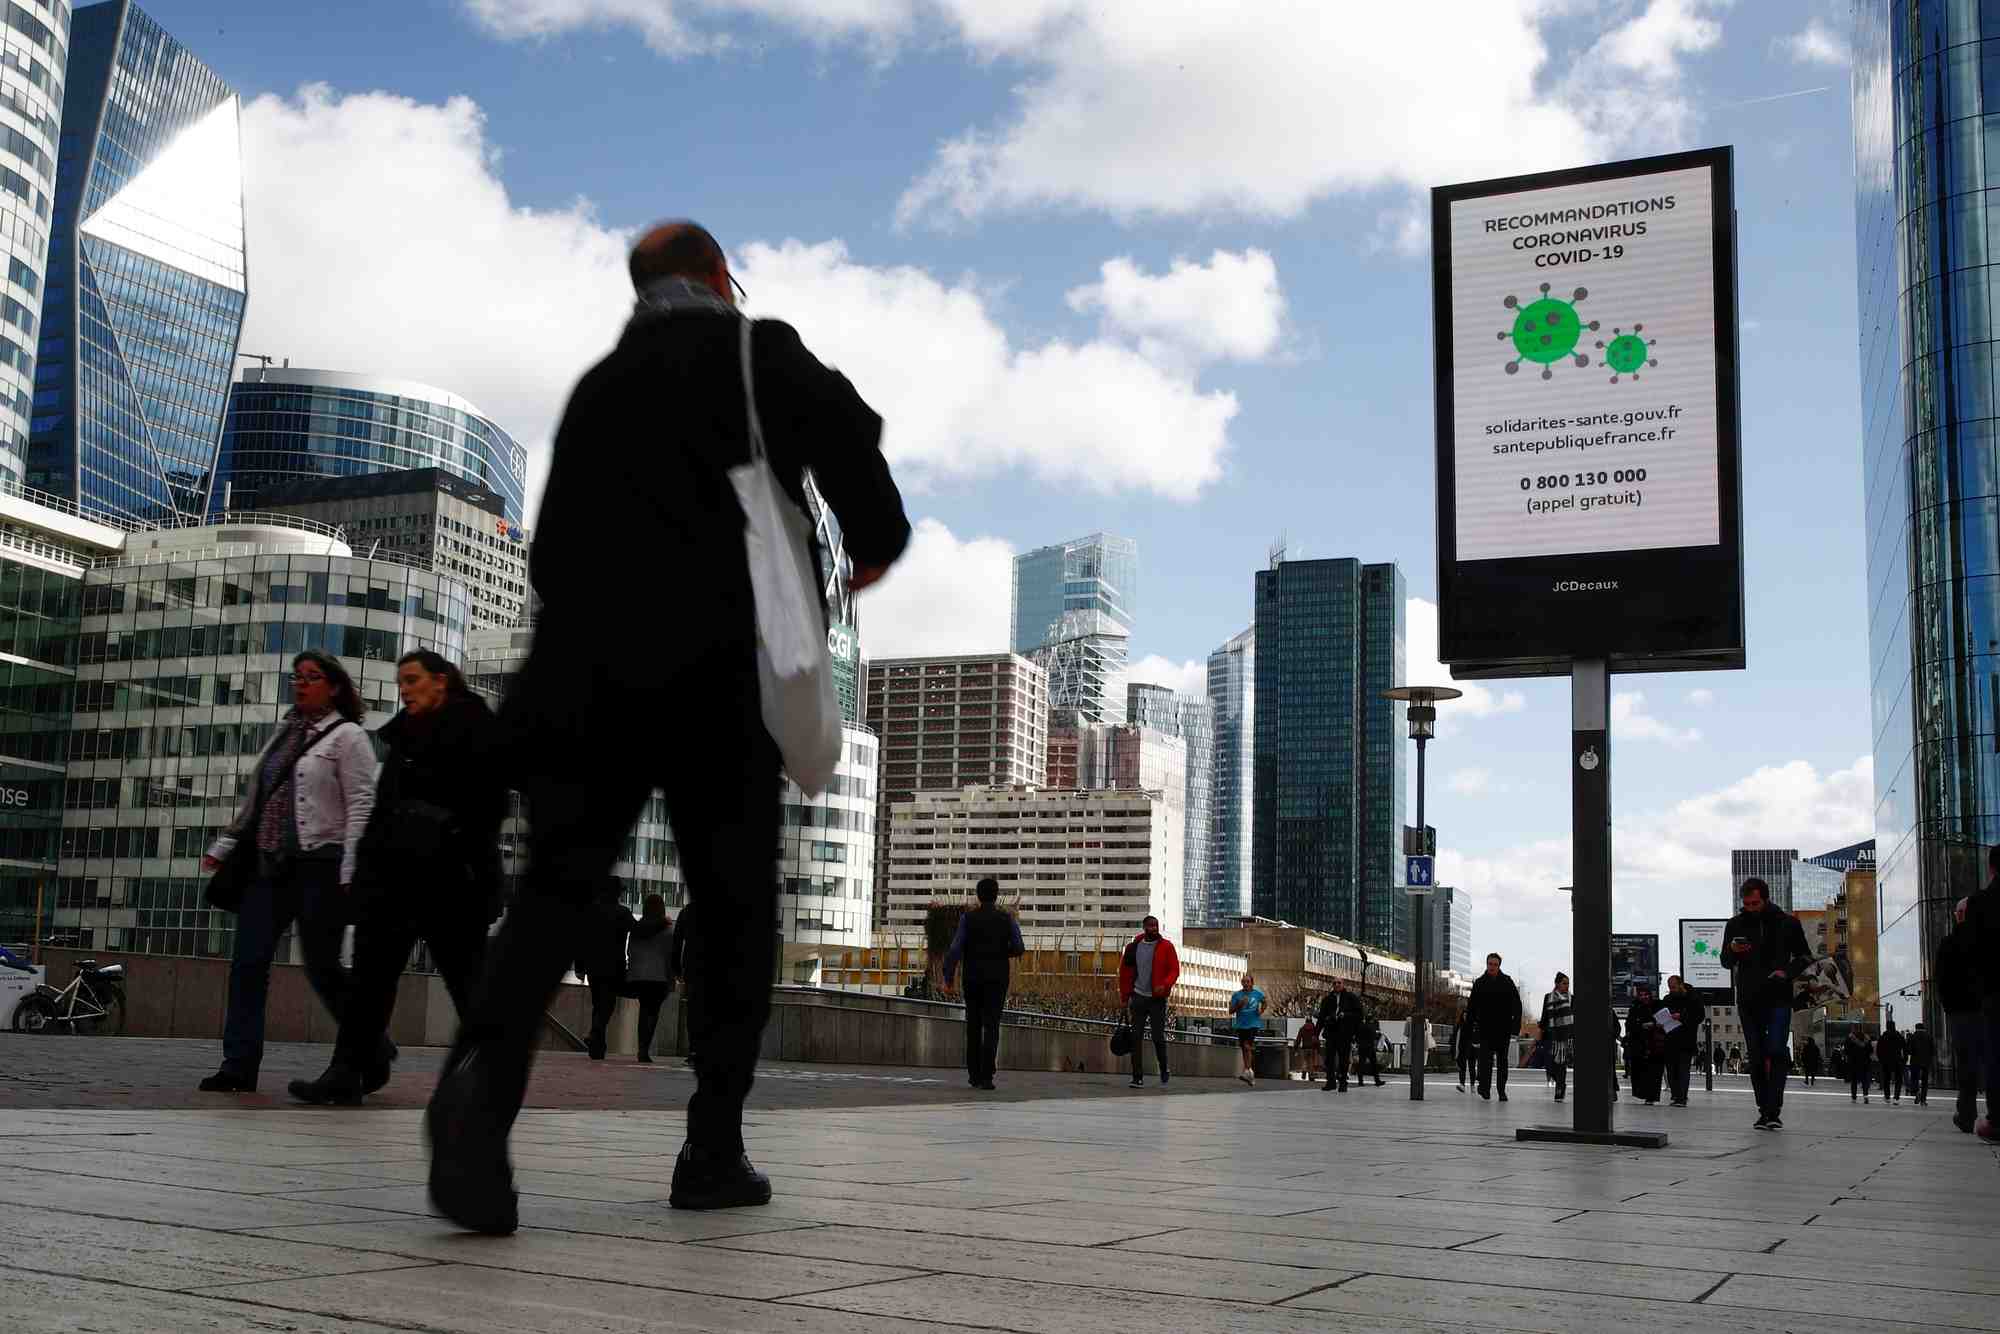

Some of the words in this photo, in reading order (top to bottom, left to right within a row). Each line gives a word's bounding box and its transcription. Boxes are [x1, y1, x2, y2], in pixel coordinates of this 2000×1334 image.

[1485, 195, 1676, 233] RECOMMANDATIONS
[1512, 221, 1647, 251] CORONAVIRUS
[1534, 244, 1624, 268] COVID-19
[1485, 405, 1683, 434] solidarites-sante.gouv.fr
[1493, 427, 1676, 455] santepubliquefrance.fr
[1520, 477, 1531, 490] 0
[1536, 474, 1570, 489] 800
[1575, 471, 1608, 487] 130
[1613, 468, 1647, 484] 000
[1527, 495, 1575, 514] (appel
[1580, 489, 1642, 511] gratuit)
[1552, 580, 1619, 592] JCDecaux
[827, 628, 851, 660] CGI
